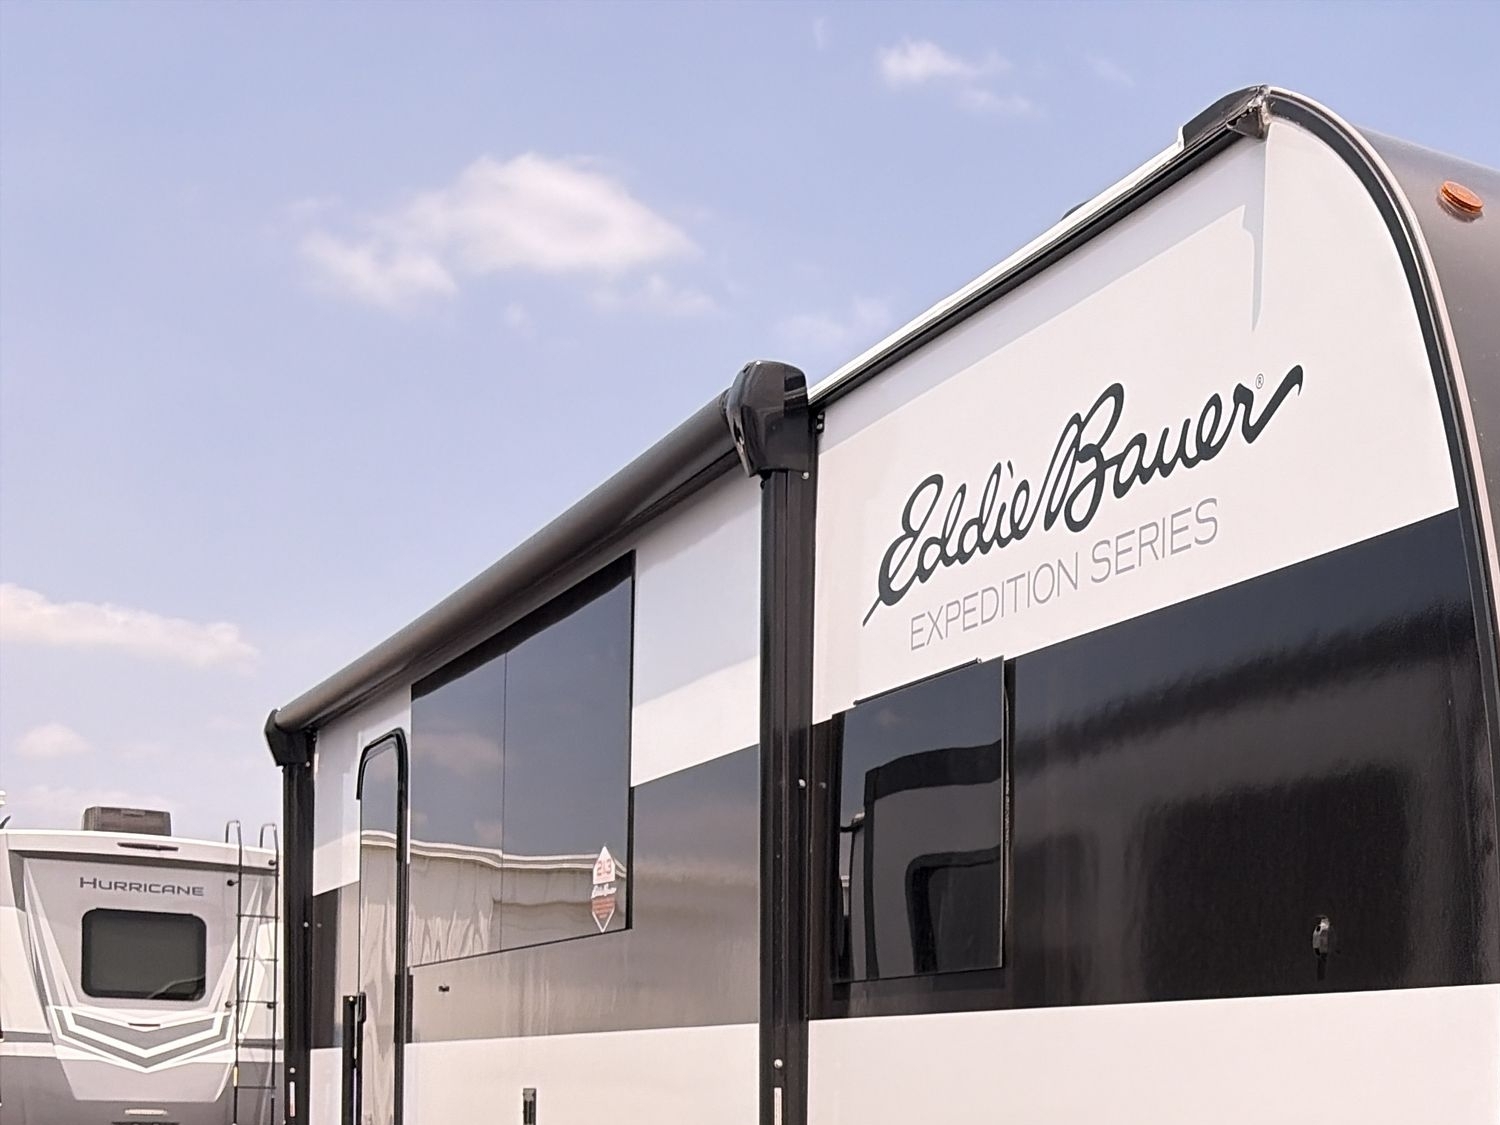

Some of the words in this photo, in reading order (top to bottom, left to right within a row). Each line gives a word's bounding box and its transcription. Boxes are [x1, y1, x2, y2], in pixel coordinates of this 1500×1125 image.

[862, 460, 1037, 627] Eddie
[910, 551, 1080, 651] EXPEDITION
[1090, 497, 1219, 584] SERIES
[79, 876, 205, 897] HURRICANE
